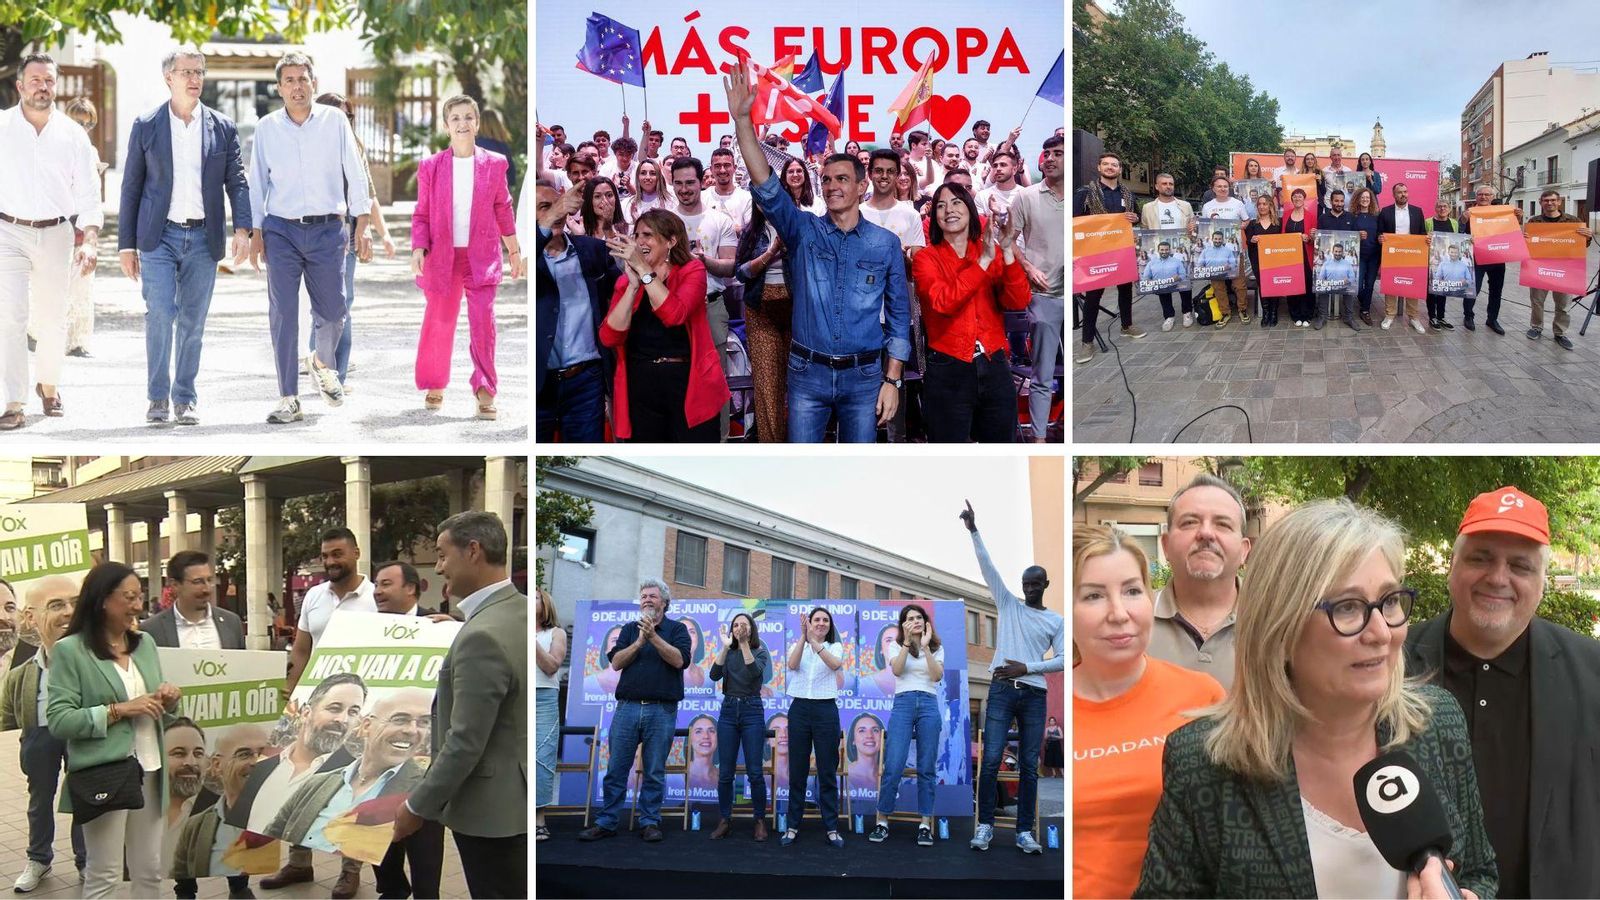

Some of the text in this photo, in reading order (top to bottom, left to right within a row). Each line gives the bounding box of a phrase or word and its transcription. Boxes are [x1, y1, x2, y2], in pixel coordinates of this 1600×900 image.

[774, 26, 1030, 75] EUROPA
[1089, 266, 1119, 275] Sumar
[1193, 265, 1225, 274] Plantem
[1139, 277, 1175, 288] Plantem
[1140, 285, 1158, 293] cara
[1500, 493, 1525, 508] Cs
[0, 516, 27, 532] OX
[33, 543, 48, 571] A
[50, 534, 83, 568] OÍR
[682, 603, 717, 613] JUNIO
[790, 605, 798, 615] 9
[592, 611, 642, 622] 9 DE JUN
[862, 611, 870, 621] 9
[872, 611, 888, 621] DE
[384, 624, 420, 640] VOX
[193, 659, 228, 677] VOX
[356, 654, 404, 680] VAN
[400, 654, 423, 681] A
[684, 687, 713, 695] ontero
[182, 682, 278, 720] VAN A OÍR
[683, 701, 699, 711] DE
[701, 701, 722, 711] JUN
[845, 700, 861, 709] DE
